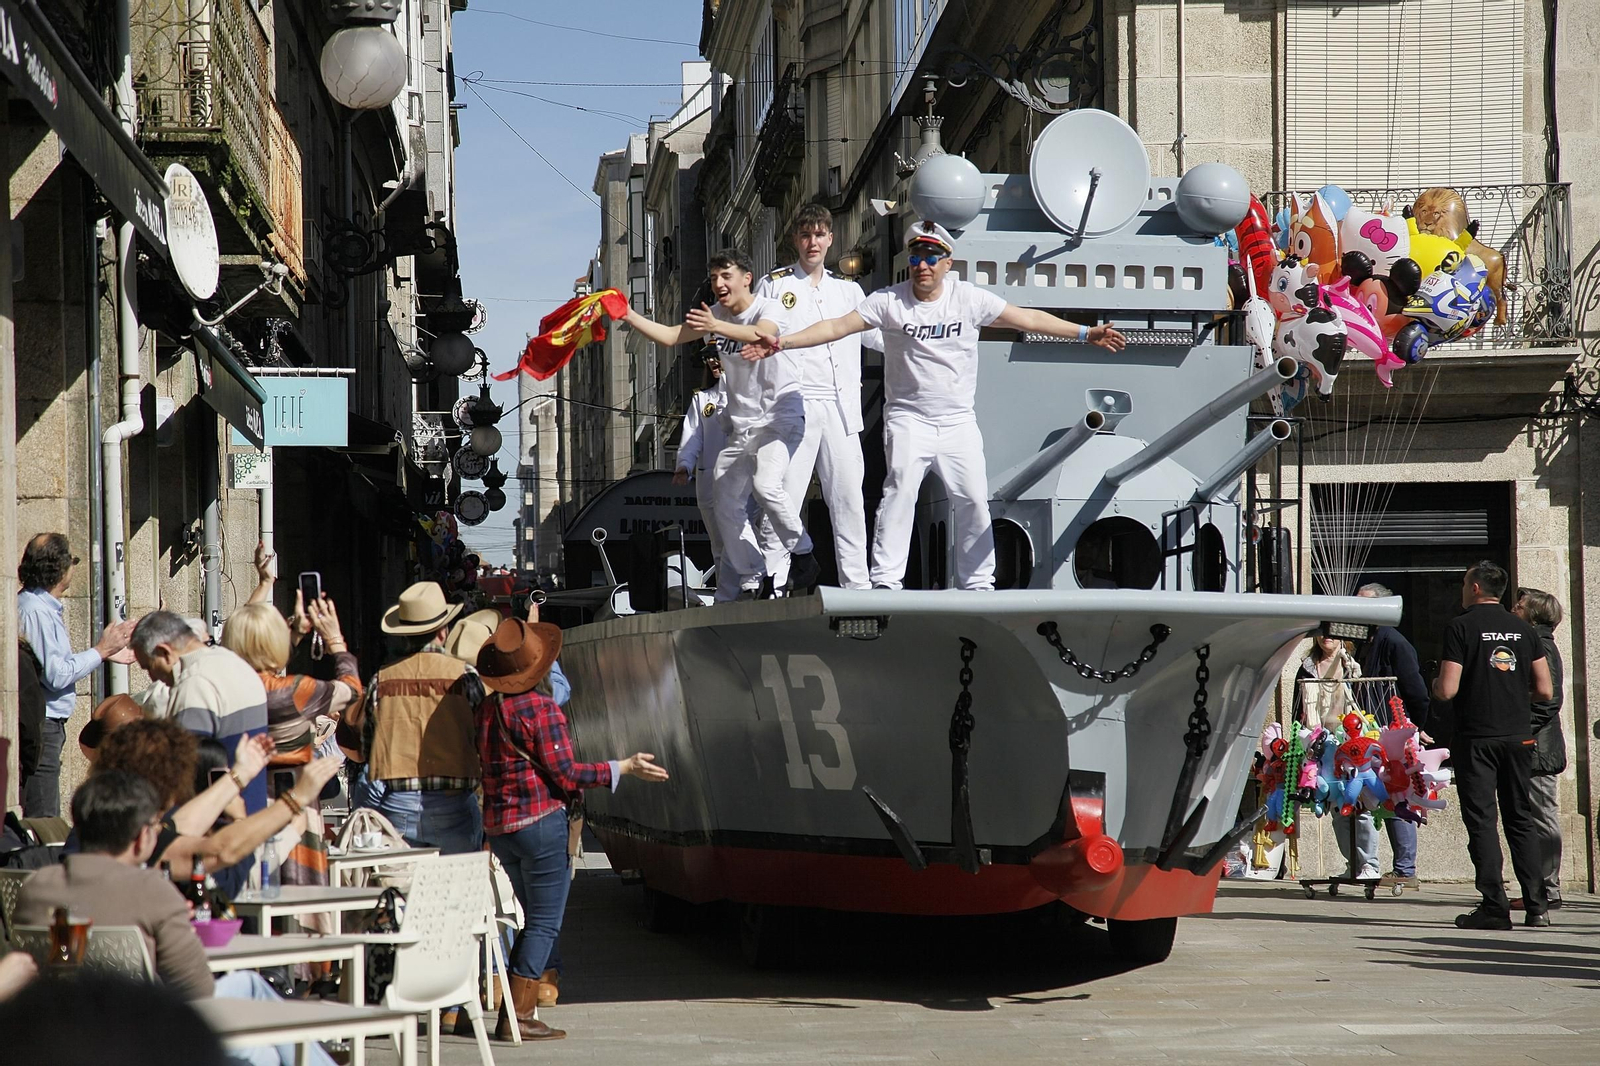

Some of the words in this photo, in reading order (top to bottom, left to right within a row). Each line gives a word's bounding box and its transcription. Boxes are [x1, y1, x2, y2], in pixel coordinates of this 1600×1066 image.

[903, 321, 962, 341] AQUA
[623, 495, 671, 506] DALTON
[620, 518, 674, 536] LUCKY
[1481, 632, 1522, 642] STAFF
[761, 655, 857, 790] 13
